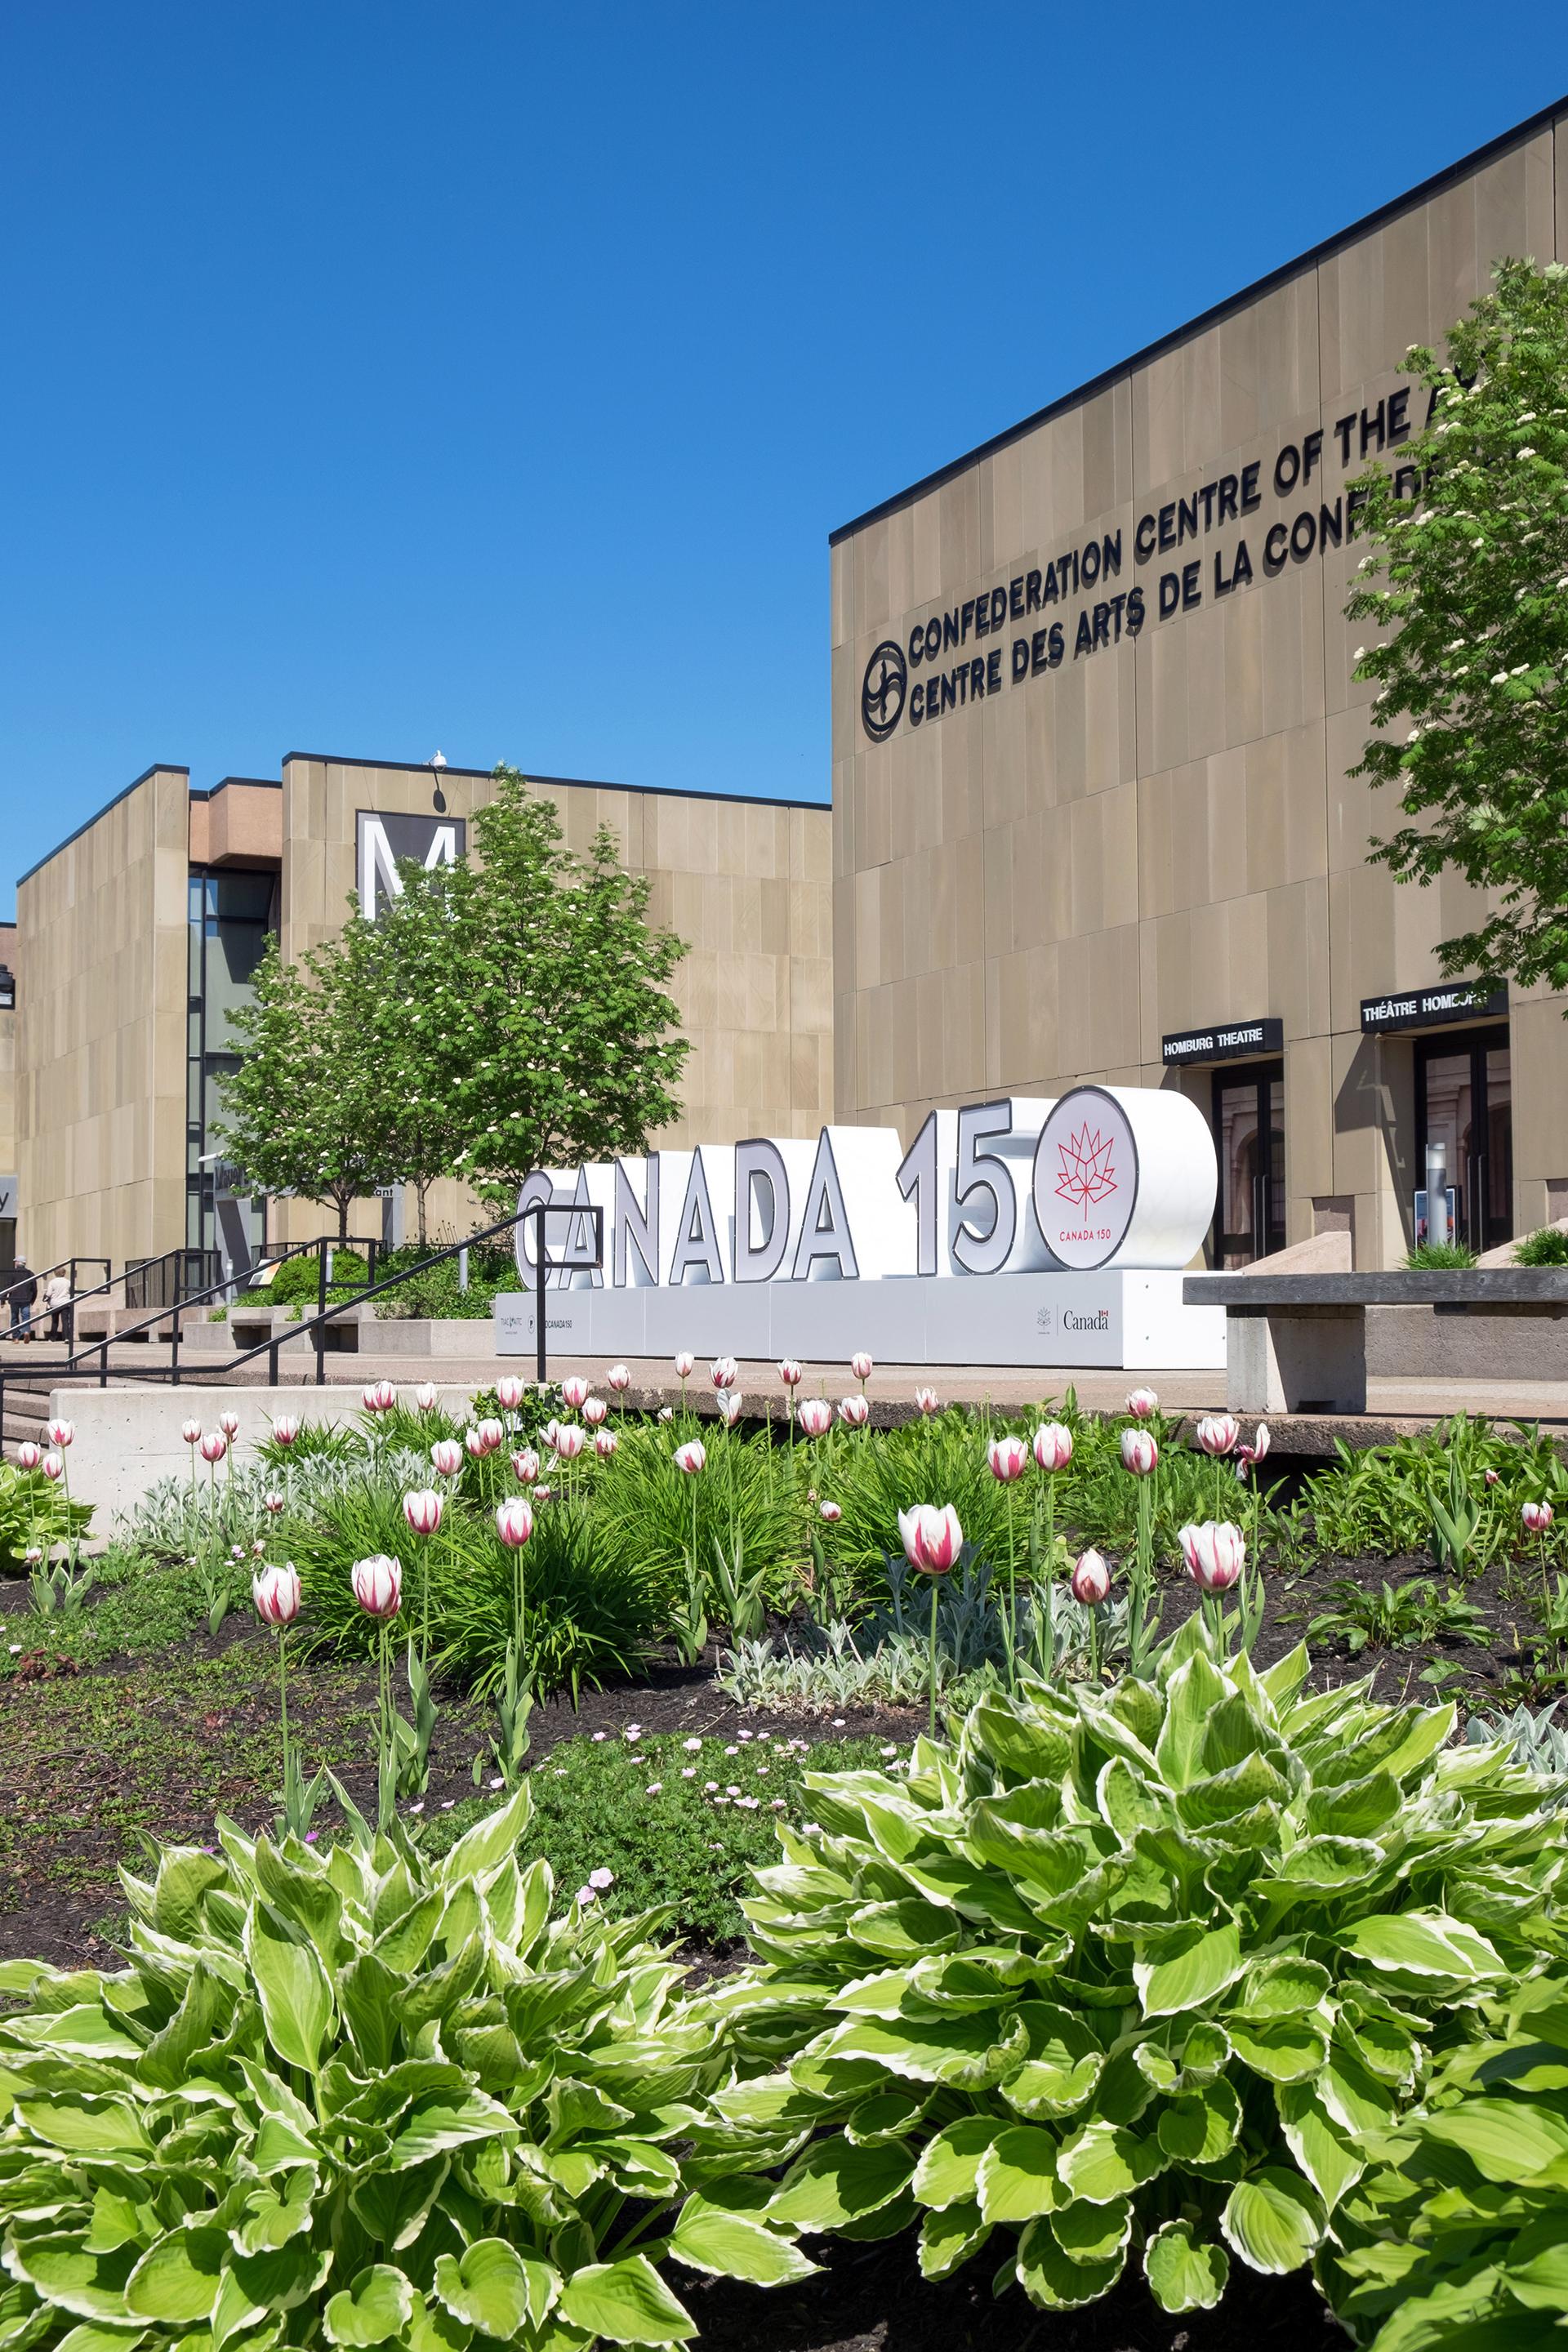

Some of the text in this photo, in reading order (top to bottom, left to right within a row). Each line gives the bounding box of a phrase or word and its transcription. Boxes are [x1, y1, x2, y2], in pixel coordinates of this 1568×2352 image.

[908, 528, 1121, 663] CONFEDERATION
[1136, 460, 1262, 555] CENTRE
[1275, 429, 1324, 490] OF
[1335, 385, 1411, 461] THE
[910, 648, 1002, 721] CENTRE
[1013, 621, 1064, 680] DES
[1075, 586, 1146, 655] ARTS
[1160, 559, 1202, 614] DE
[1215, 539, 1254, 592] LA
[1362, 1000, 1417, 1022] THÉÂTRE
[1164, 1027, 1263, 1057] HOMBURG THEATRE
[514, 1084, 1139, 1292] CANADA 150
[1058, 1228, 1111, 1242] CANADA 150
[1063, 1309, 1109, 1330] Canada
